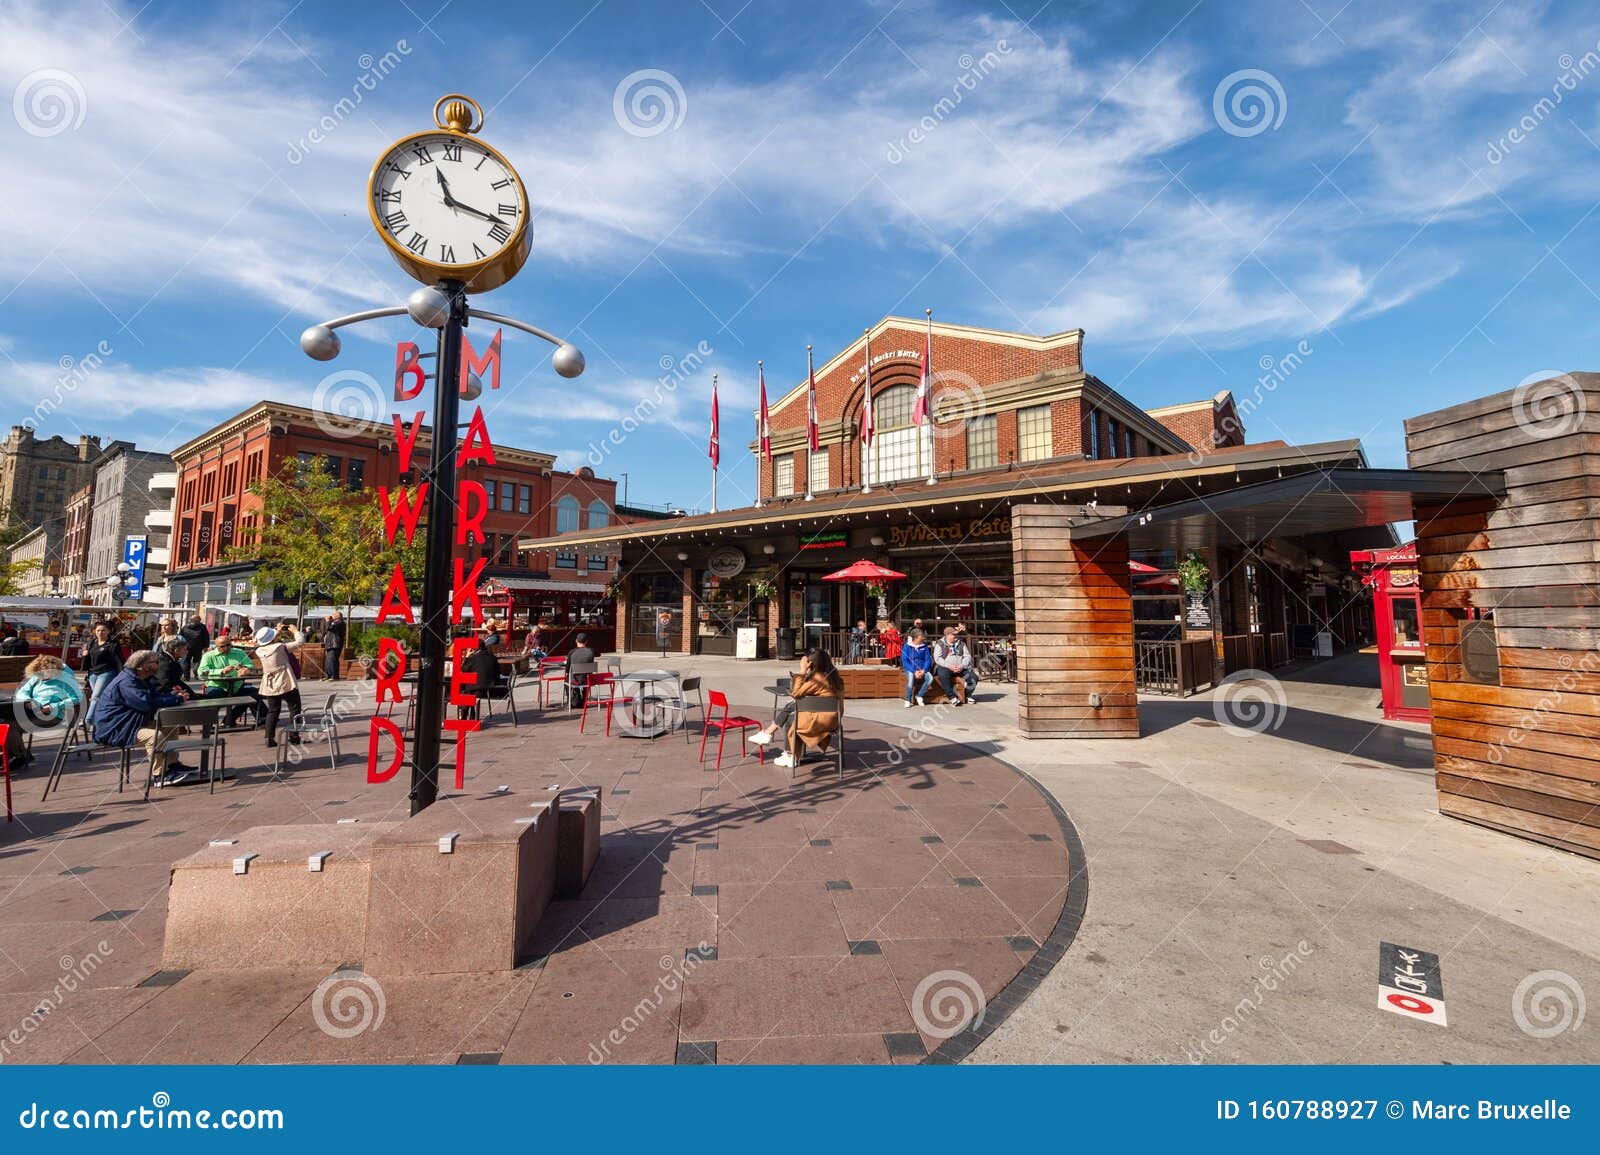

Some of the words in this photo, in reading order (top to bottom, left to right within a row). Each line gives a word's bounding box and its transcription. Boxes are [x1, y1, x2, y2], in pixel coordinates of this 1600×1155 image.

[413, 146, 434, 166] XI
[442, 144, 463, 162] XII
[390, 163, 411, 180] X
[491, 178, 510, 191] II
[381, 189, 401, 203] IX
[498, 203, 516, 217] III
[385, 210, 410, 235] VIII
[406, 232, 429, 255] VII
[472, 242, 487, 260] V
[440, 244, 456, 263] VI
[201, 527, 210, 543] EQ3
[223, 520, 233, 538] EQ3
[890, 521, 962, 547] ByWard
[129, 541, 142, 556] P
[181, 532, 190, 548] EQ3
[367, 341, 430, 785] BYWARD
[443, 327, 502, 790] MARKET
